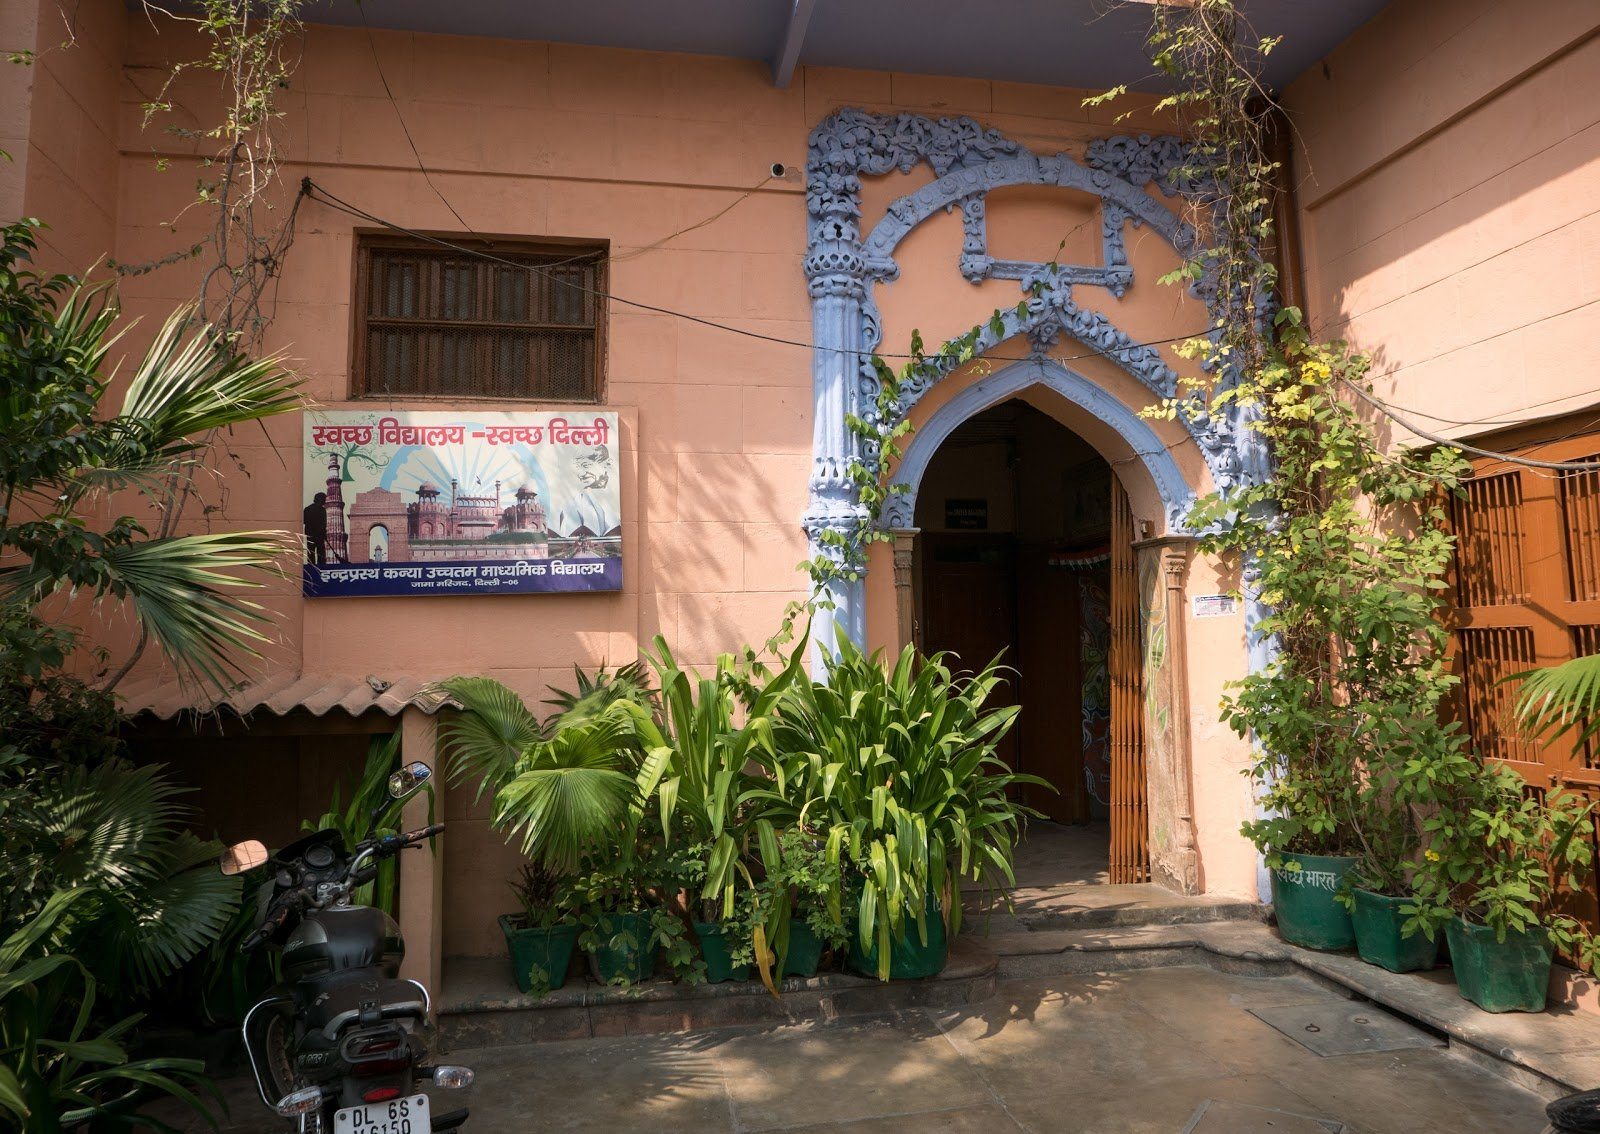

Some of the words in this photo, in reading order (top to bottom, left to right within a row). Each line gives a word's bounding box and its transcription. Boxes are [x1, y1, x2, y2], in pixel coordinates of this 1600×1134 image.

[312, 426, 373, 446] स्वच्छ
[378, 417, 465, 446] विद्यालय
[548, 417, 609, 446] दिल्ली
[320, 568, 380, 583] इन्द्रप्रस्थ
[383, 567, 423, 580] कन्या
[426, 566, 478, 579] उच्चतम
[481, 561, 547, 577] माध्यमिक
[550, 560, 605, 576] विद्यालय
[474, 578, 500, 587] दिल्ली
[1305, 870, 1337, 892] भारत
[353, 1107, 375, 1128] DL
[388, 1100, 409, 1120] 6S
